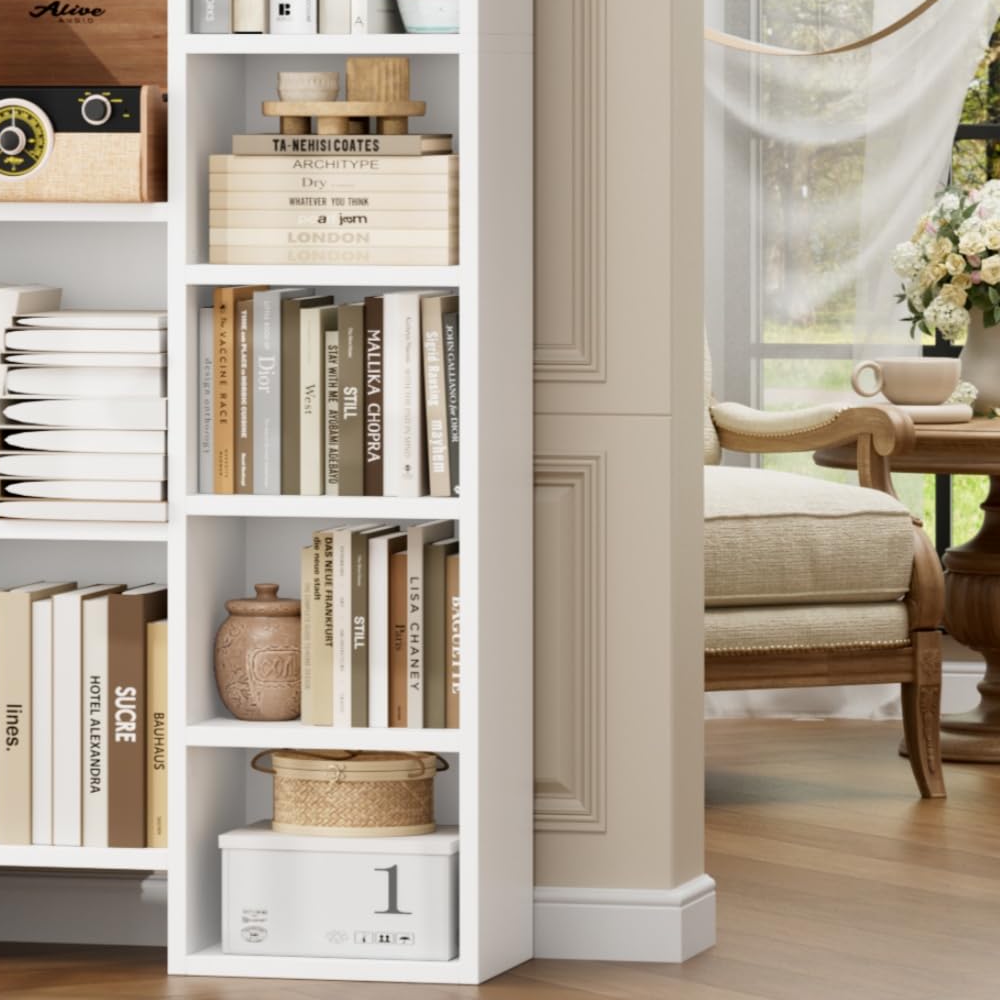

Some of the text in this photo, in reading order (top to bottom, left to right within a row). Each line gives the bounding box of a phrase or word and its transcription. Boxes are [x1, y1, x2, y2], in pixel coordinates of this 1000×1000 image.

[29, 1, 105, 18] Alive
[272, 139, 379, 152] TA-NEHISI COATES
[293, 159, 379, 169] ARCHITYPE
[302, 177, 326, 190] Dry
[290, 197, 369, 206] WHATEVER YOU THINK
[288, 232, 370, 243] LONDON
[288, 251, 370, 261] LONDON
[219, 331, 227, 386] VACCINE
[258, 356, 276, 393] Dior
[328, 345, 338, 403] STAY WITH ME
[304, 384, 316, 414] West
[367, 330, 380, 462] MALLIKA CHOPRA
[446, 325, 459, 442] JOHN GALLIANO for DIOR
[343, 387, 357, 419] STILL
[425, 331, 446, 472] Sigrid Rausing mayhem
[313, 537, 321, 549] die
[313, 578, 321, 601] stadt
[325, 537, 333, 647] DAS NEUE FRANKFURT
[354, 616, 365, 649] STILL
[394, 624, 406, 652] Paris
[410, 577, 419, 691] LISA CHANEY
[6, 704, 22, 751] lines.
[115, 686, 136, 742] SUCRE
[90, 676, 101, 793] HOTEL ALEXANDRA
[153, 712, 164, 770] BAUHAUS
[374, 864, 412, 915] 1
